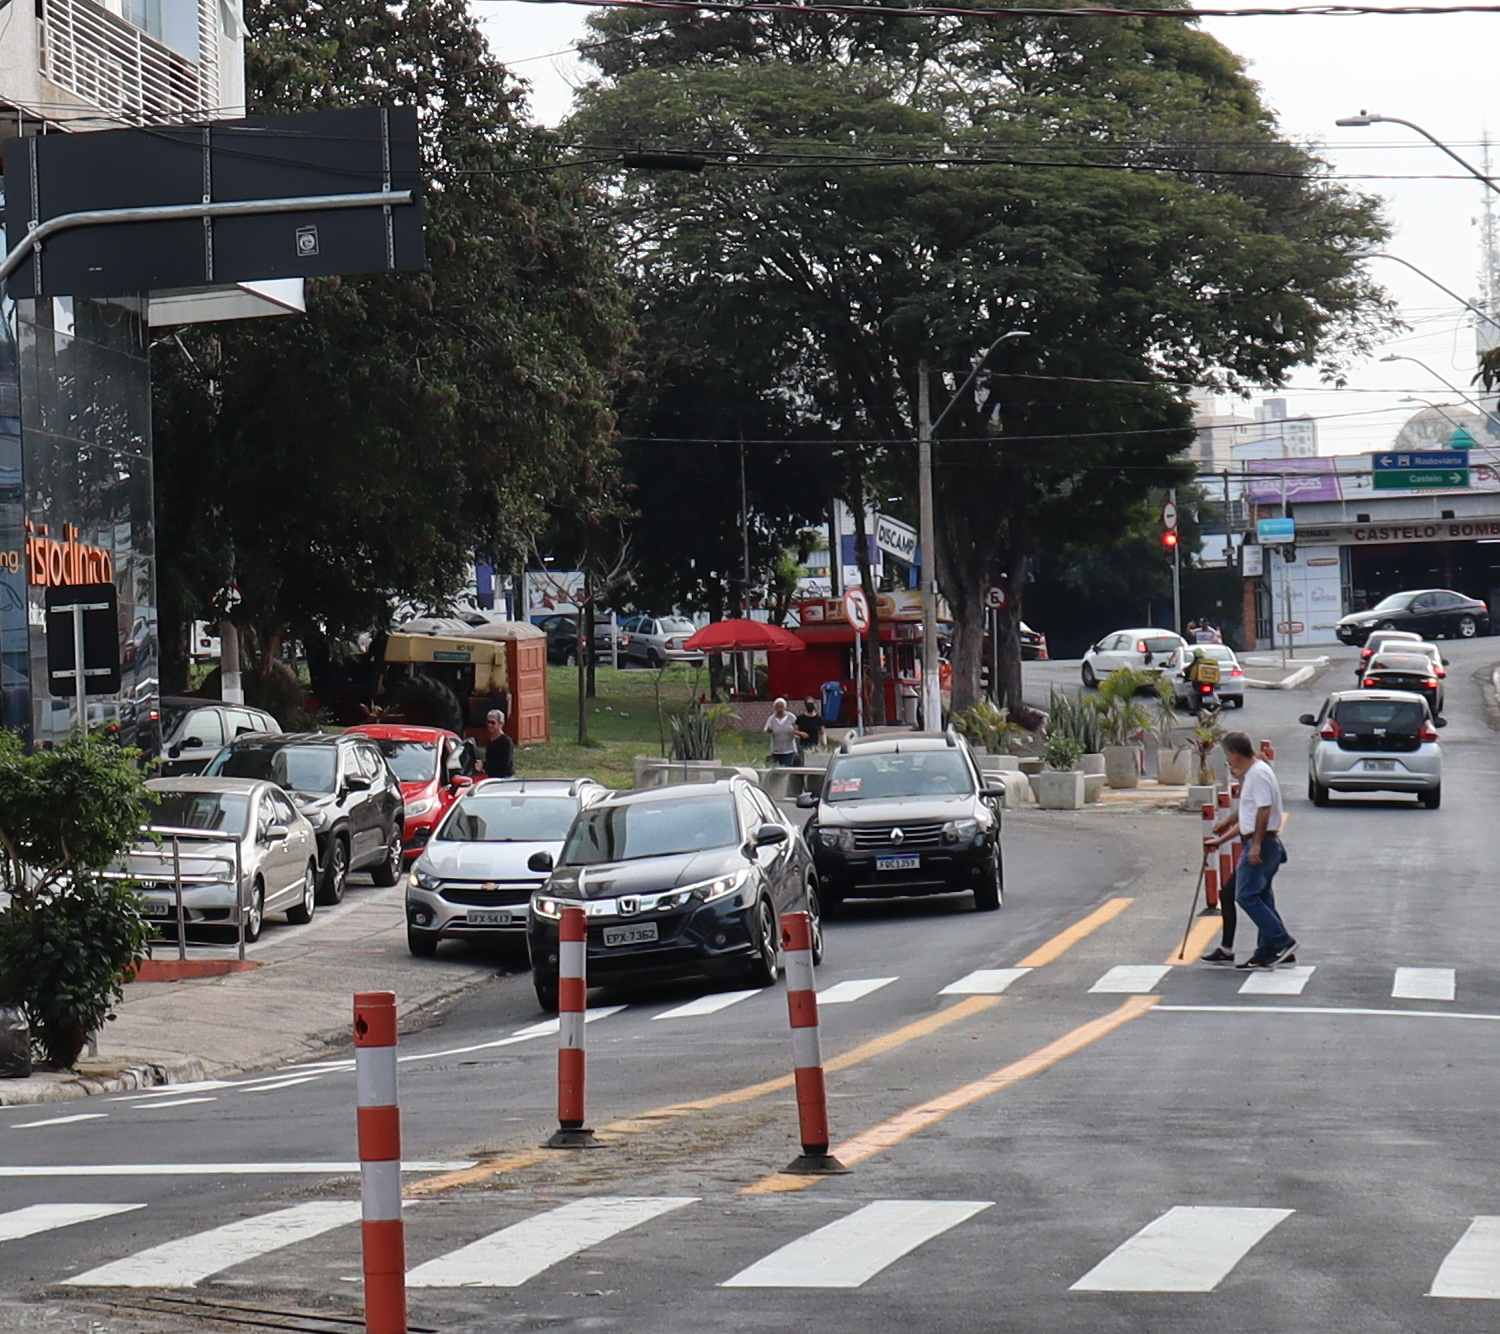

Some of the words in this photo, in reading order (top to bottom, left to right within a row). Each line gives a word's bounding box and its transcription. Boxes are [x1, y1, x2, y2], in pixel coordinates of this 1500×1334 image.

[1414, 456, 1463, 466] Rodoviária
[1408, 474, 1443, 483] Castelo
[878, 524, 915, 556] DISCAMP
[606, 929, 656, 944] EPX-7362
